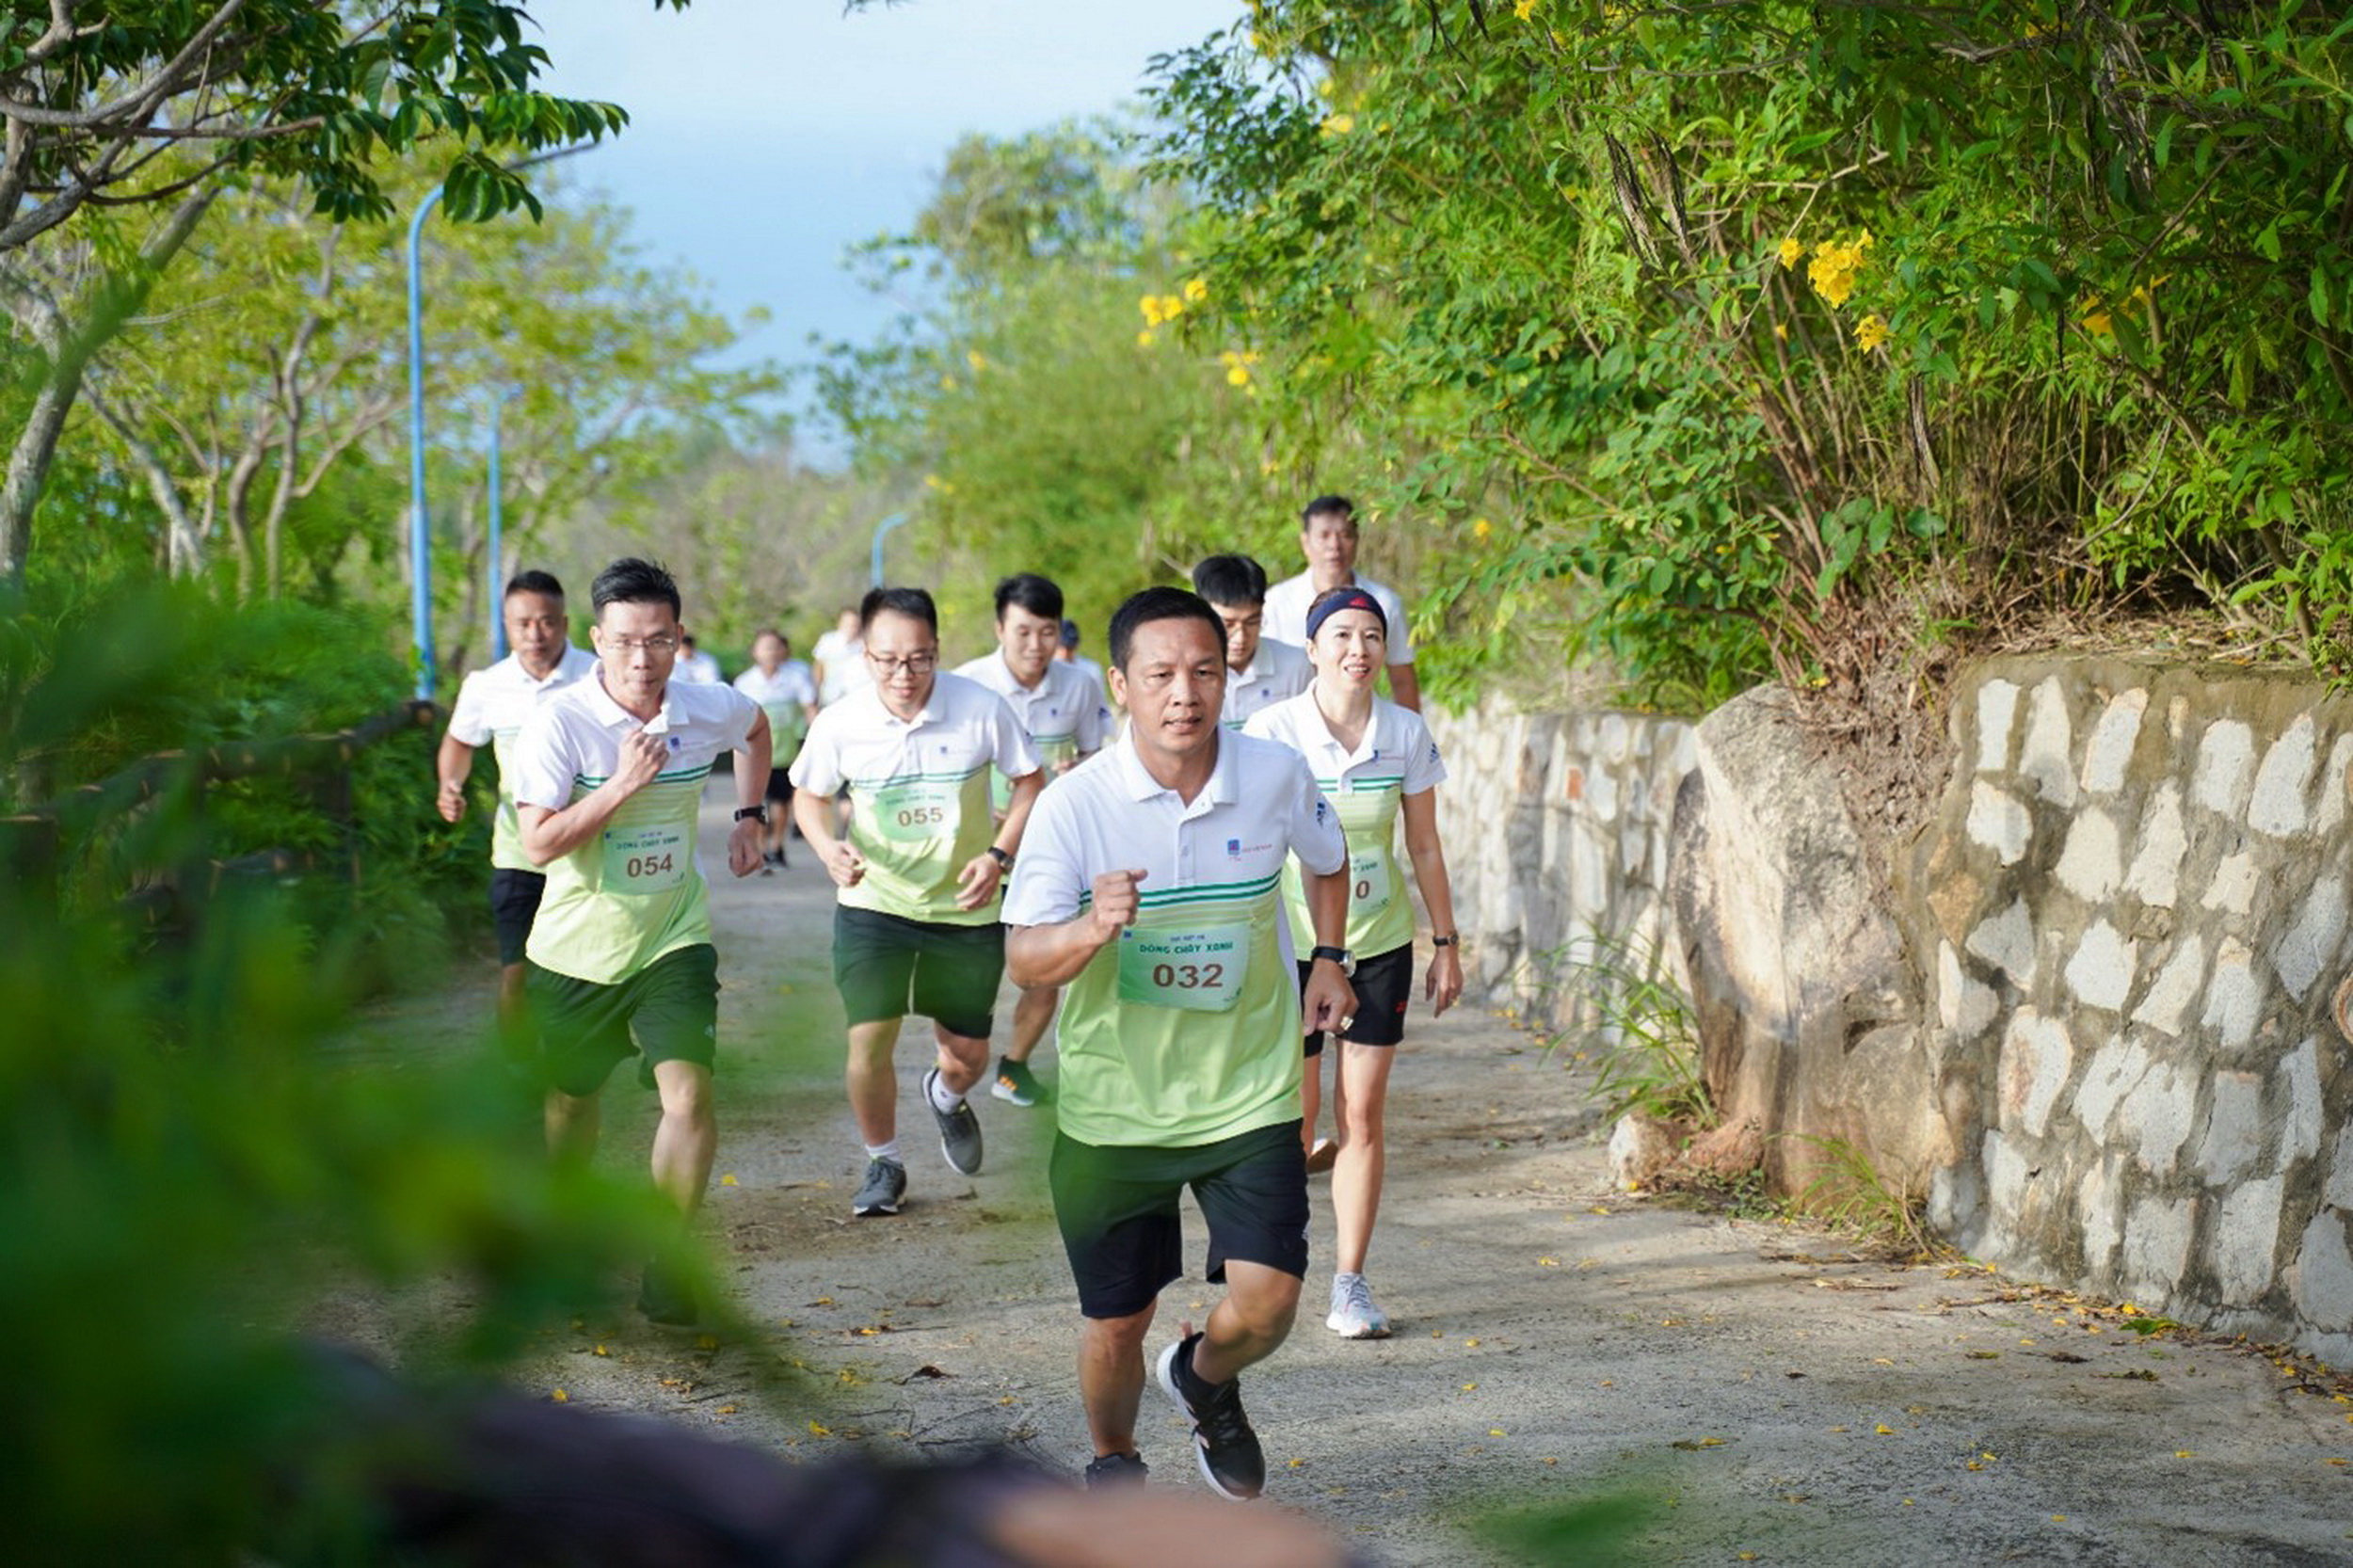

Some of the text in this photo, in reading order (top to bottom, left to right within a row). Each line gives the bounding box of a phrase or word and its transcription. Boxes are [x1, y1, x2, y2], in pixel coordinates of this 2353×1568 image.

[898, 807, 943, 827] 055
[627, 853, 672, 878] 054
[1153, 963, 1223, 988] 032
